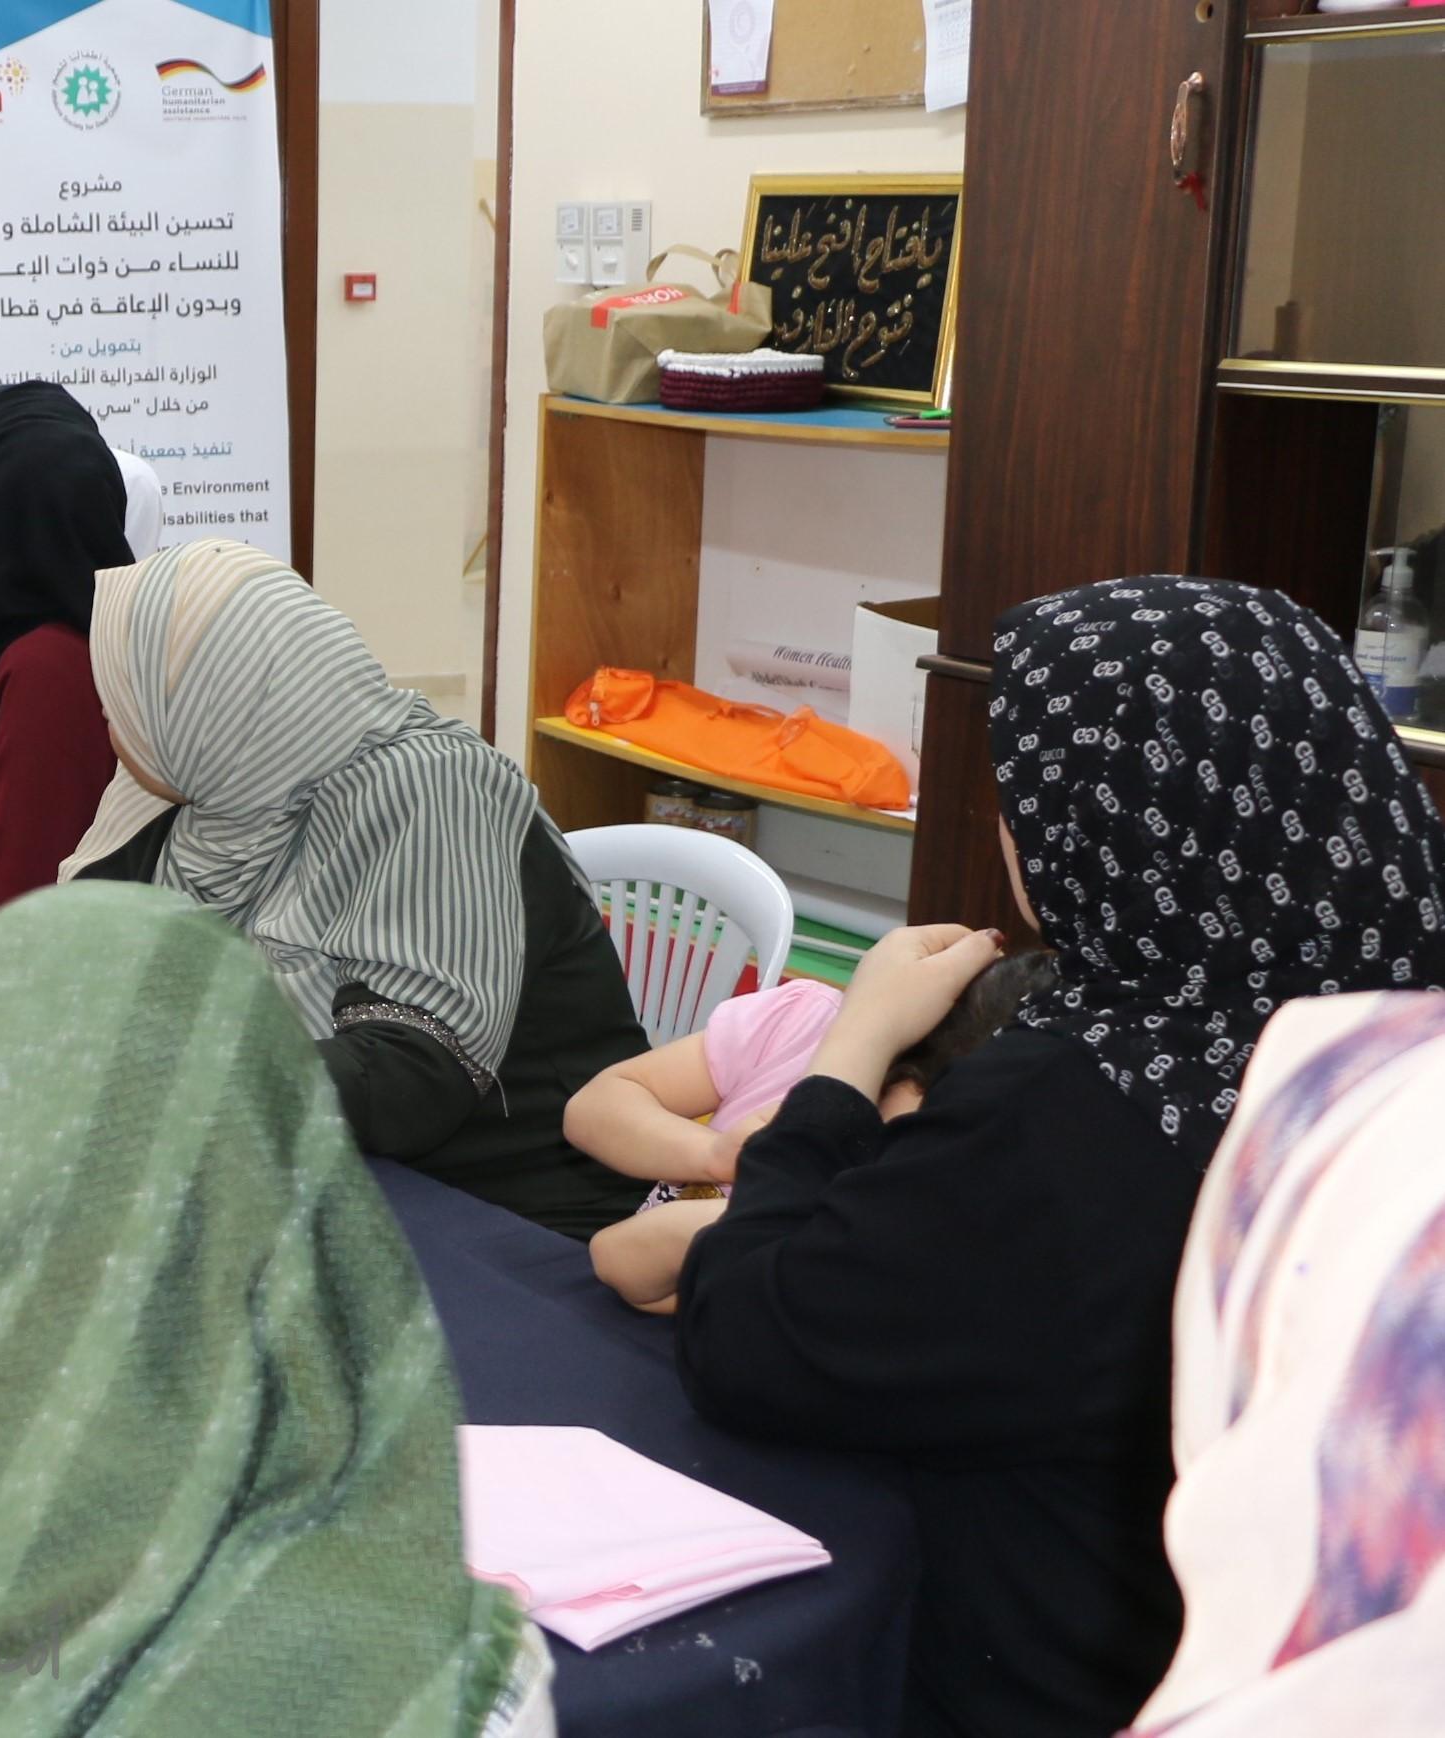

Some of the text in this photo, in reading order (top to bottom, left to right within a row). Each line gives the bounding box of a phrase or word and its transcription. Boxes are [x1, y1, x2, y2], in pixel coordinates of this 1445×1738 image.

[161, 85, 214, 97] German
[161, 96, 226, 106] humanitarian
[162, 106, 212, 115] assistance
[59, 174, 122, 200] مشروع
[20, 212, 100, 235] الشاملة
[107, 211, 159, 238] البيئة
[166, 212, 234, 237] تحسين
[56, 253, 108, 280] ذوات
[115, 257, 161, 278] من
[168, 250, 239, 271] للنساء
[47, 298, 83, 325] في
[91, 292, 169, 320] الإعاقة
[176, 295, 241, 317] وبدون
[60, 340, 83, 358] من
[88, 338, 141, 357] بتمويل
[100, 366, 165, 385] الفدرالية
[169, 364, 218, 384] الوزارة
[146, 398, 181, 416] خلال
[186, 399, 209, 415] من
[140, 444, 186, 461] جمعية
[192, 441, 233, 460] تنفيذ
[173, 479, 269, 495] Environment
[162, 509, 269, 526] isabilities that
[1073, 620, 1118, 634] GUCCI
[773, 646, 815, 664] Women
[1155, 717, 1187, 767] GUCCI
[1248, 763, 1275, 813] GUCCI
[1342, 815, 1373, 867] GUCCI
[1215, 893, 1245, 939] GUCCI
